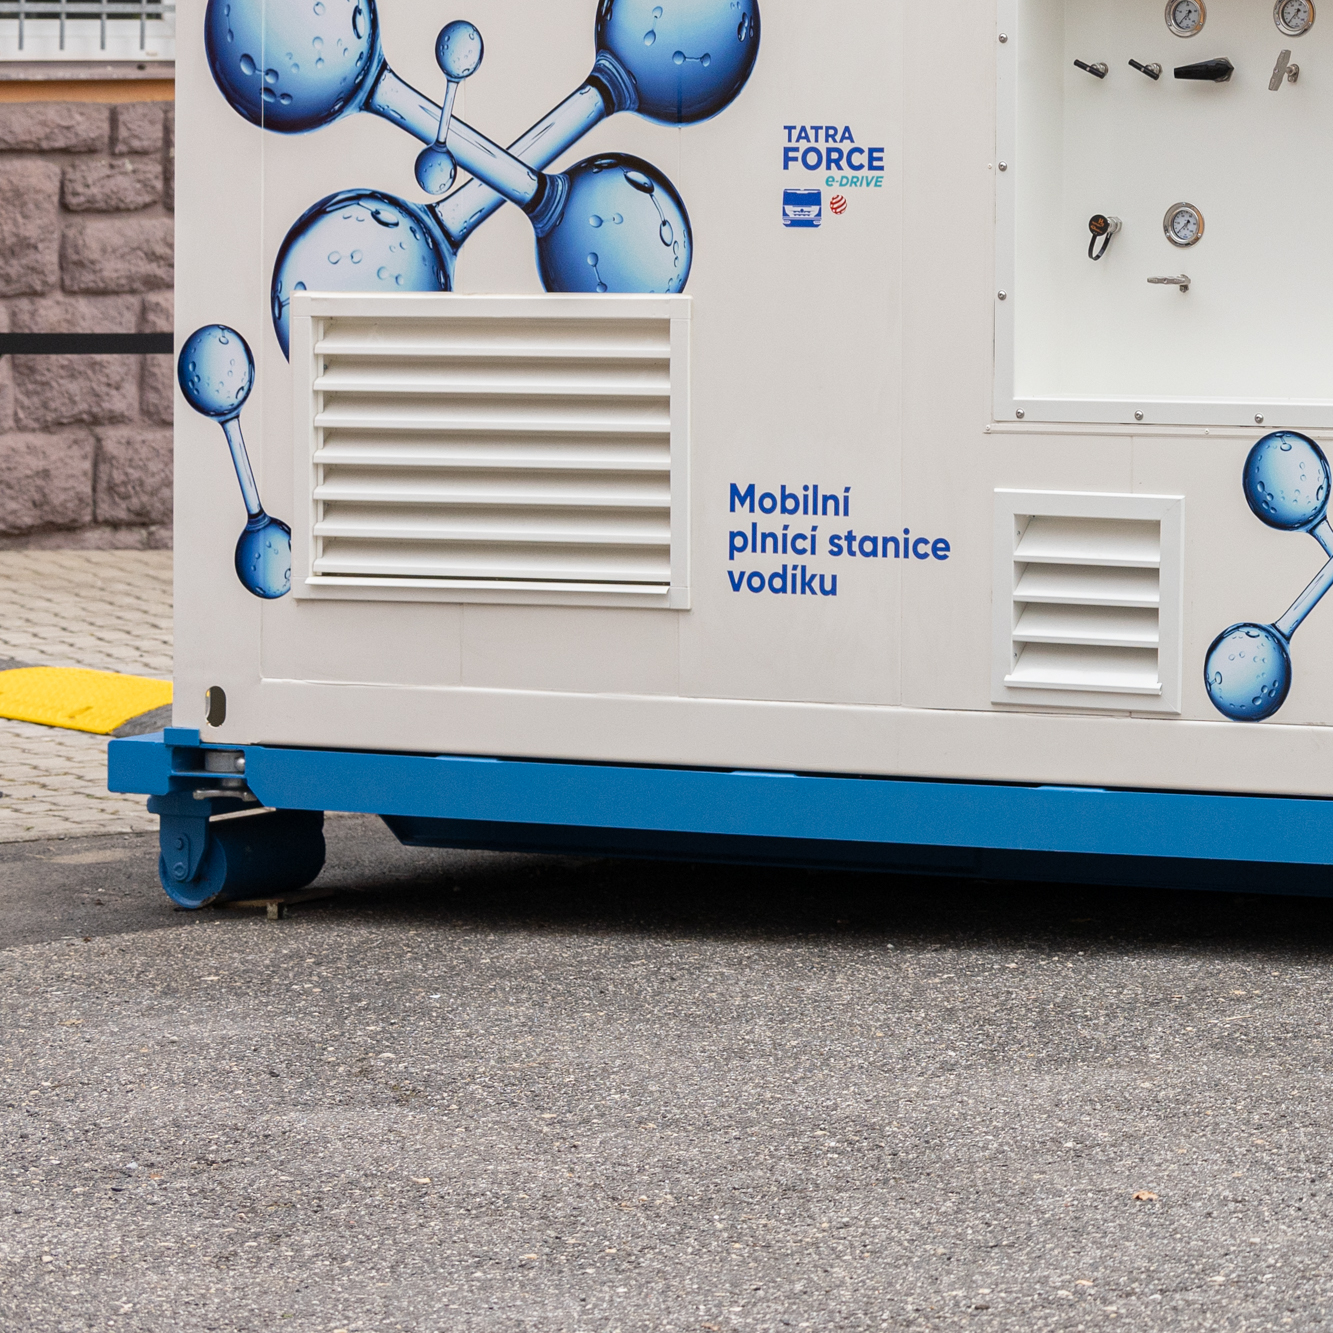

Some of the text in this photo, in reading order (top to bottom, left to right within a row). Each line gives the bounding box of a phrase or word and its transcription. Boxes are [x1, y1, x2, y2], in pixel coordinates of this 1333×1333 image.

[783, 125, 855, 143] TATRA
[782, 146, 885, 171] FORCE
[825, 175, 884, 188] e-DRIVE
[729, 482, 851, 517] Mobilní
[729, 521, 951, 561] plnící stanice
[727, 563, 838, 596] vodíku
